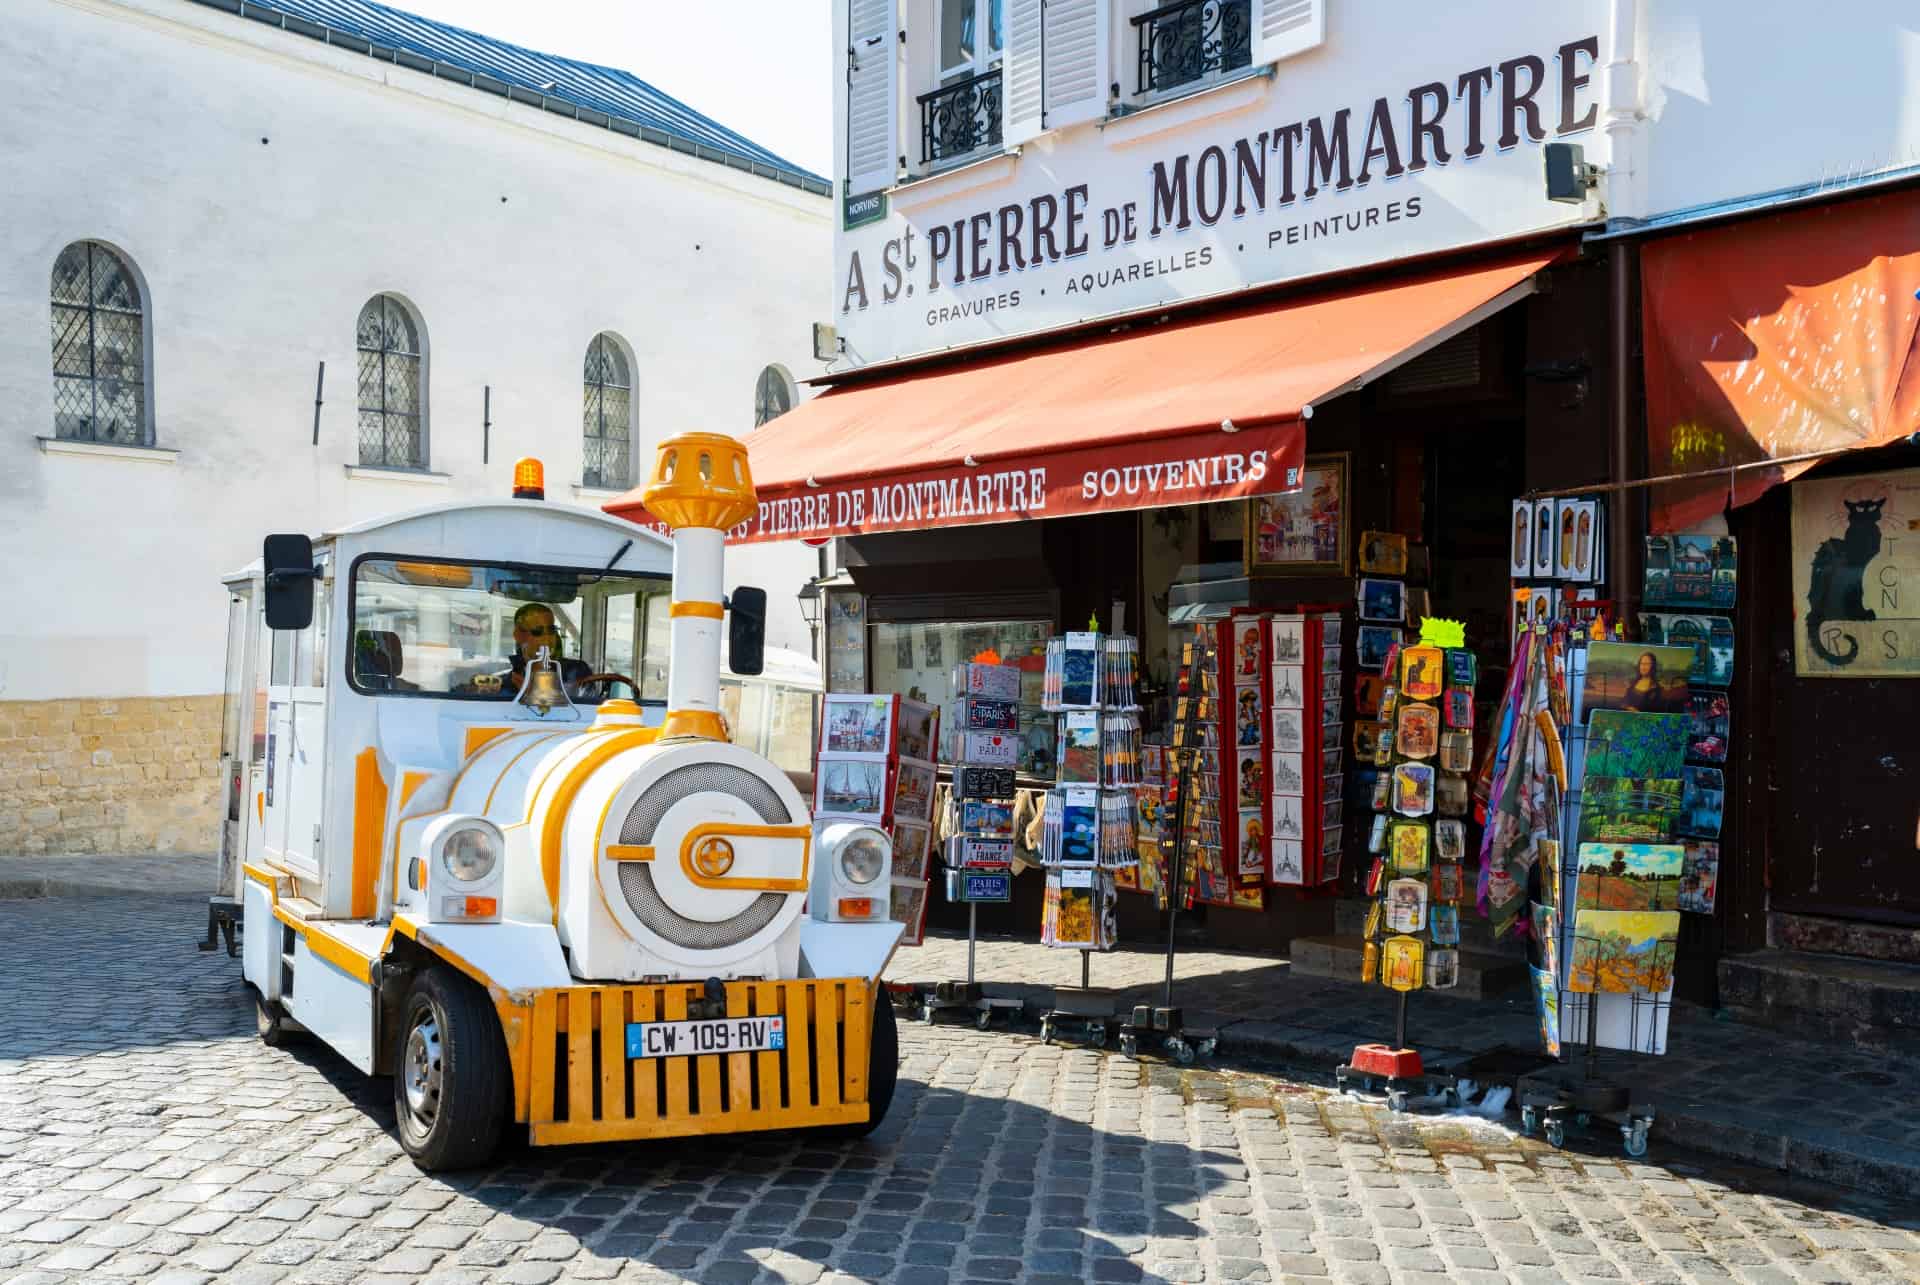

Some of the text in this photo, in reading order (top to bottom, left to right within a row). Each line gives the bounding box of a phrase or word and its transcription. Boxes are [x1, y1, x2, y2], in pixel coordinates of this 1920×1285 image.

[843, 249, 869, 314] A
[928, 182, 1089, 293] PIERRE
[1103, 201, 1138, 249] DE
[1150, 35, 1599, 236] MONTMARTRE
[926, 196, 1423, 326] GRAVURES AQUARELLES PEINTURES
[758, 493, 831, 535] PIERRE
[836, 488, 865, 527] DE
[870, 467, 1047, 525] MONTMARTRE
[1081, 450, 1268, 500] SOUVENIRS
[771, 1033, 784, 1047] 75
